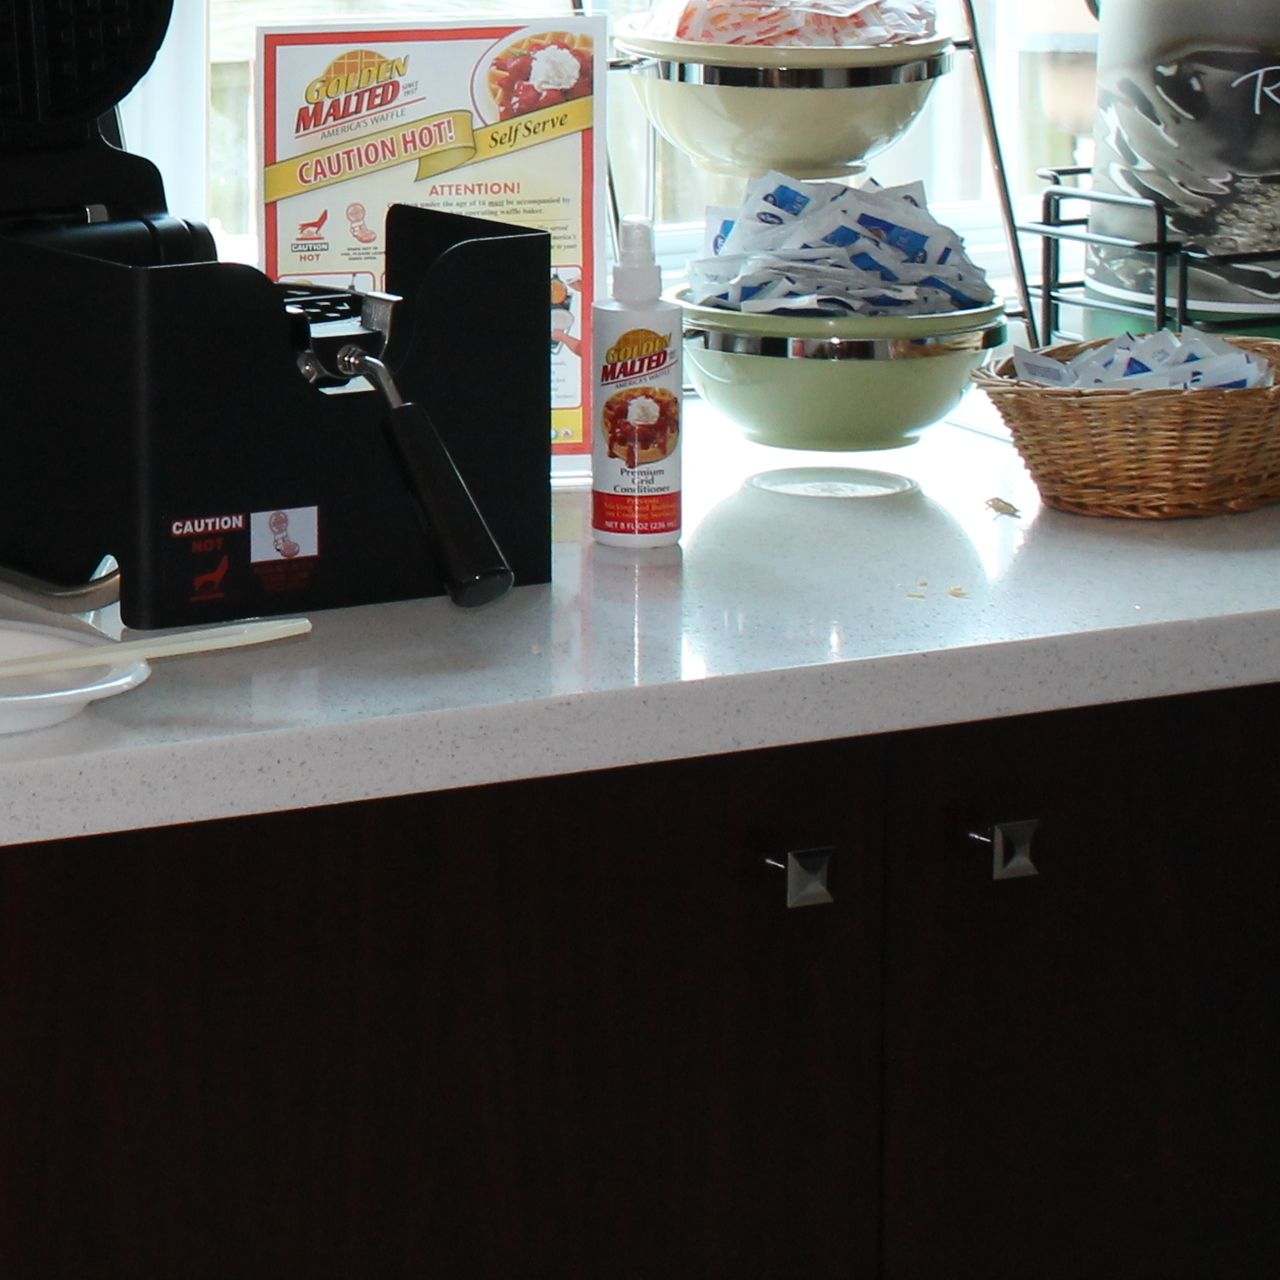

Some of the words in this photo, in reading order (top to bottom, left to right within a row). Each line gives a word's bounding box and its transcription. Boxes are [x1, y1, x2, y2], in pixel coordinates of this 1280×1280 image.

[305, 54, 410, 105] GOLDEN
[295, 79, 401, 134] MALTED
[321, 120, 368, 140] AMERICA'S
[370, 108, 406, 127] WAFFLE
[488, 126, 520, 150] Self
[521, 113, 568, 137] Serve
[297, 136, 398, 184] CAUTION
[402, 119, 455, 153] HOT!
[428, 182, 521, 196] ATTENTION!
[292, 243, 328, 251] CAUTION
[300, 254, 322, 262] HOT
[601, 350, 668, 382] MALTED
[620, 468, 665, 477] Premium
[631, 476, 655, 485] Grid
[613, 485, 671, 494] Conditioner
[172, 514, 244, 535] CAUTION
[605, 521, 619, 529] NET
